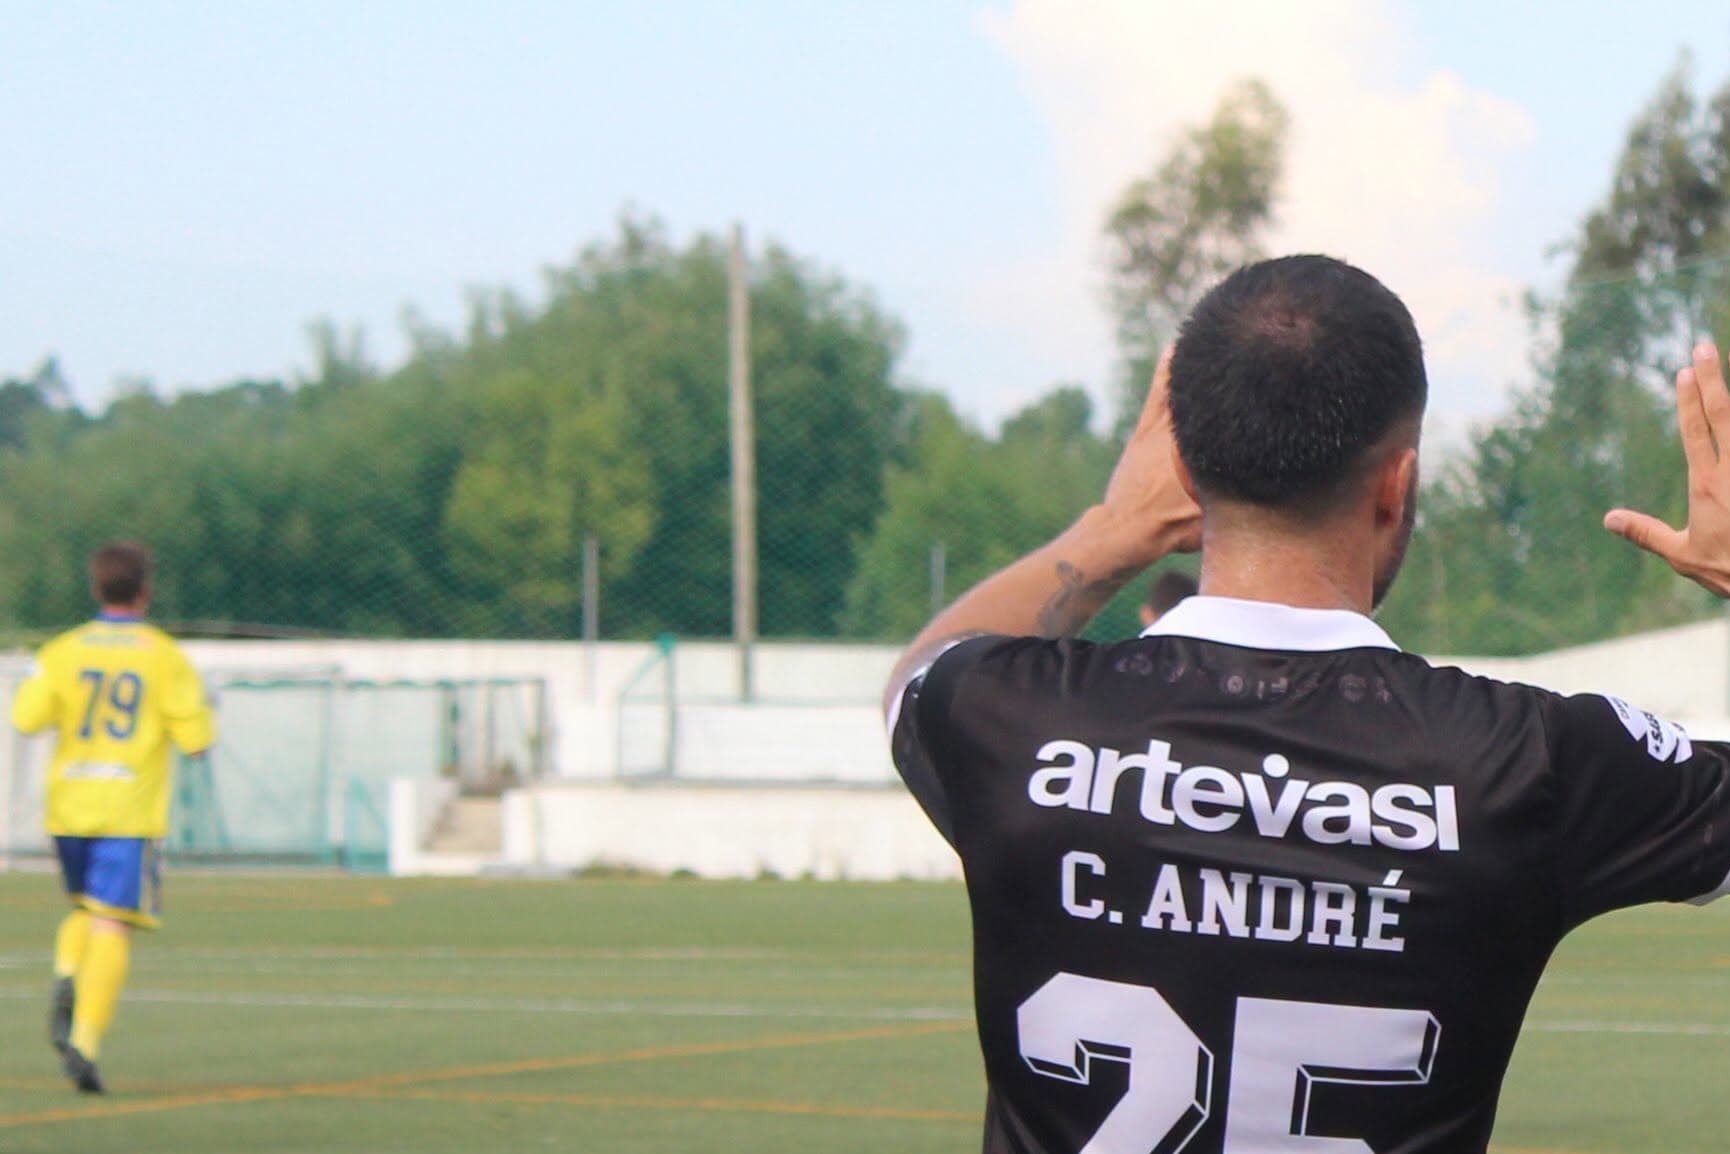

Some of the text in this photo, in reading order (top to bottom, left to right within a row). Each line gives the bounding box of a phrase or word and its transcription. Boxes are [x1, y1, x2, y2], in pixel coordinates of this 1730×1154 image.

[78, 670, 143, 741] 79
[1061, 850, 1411, 952] C. ANDRÉ
